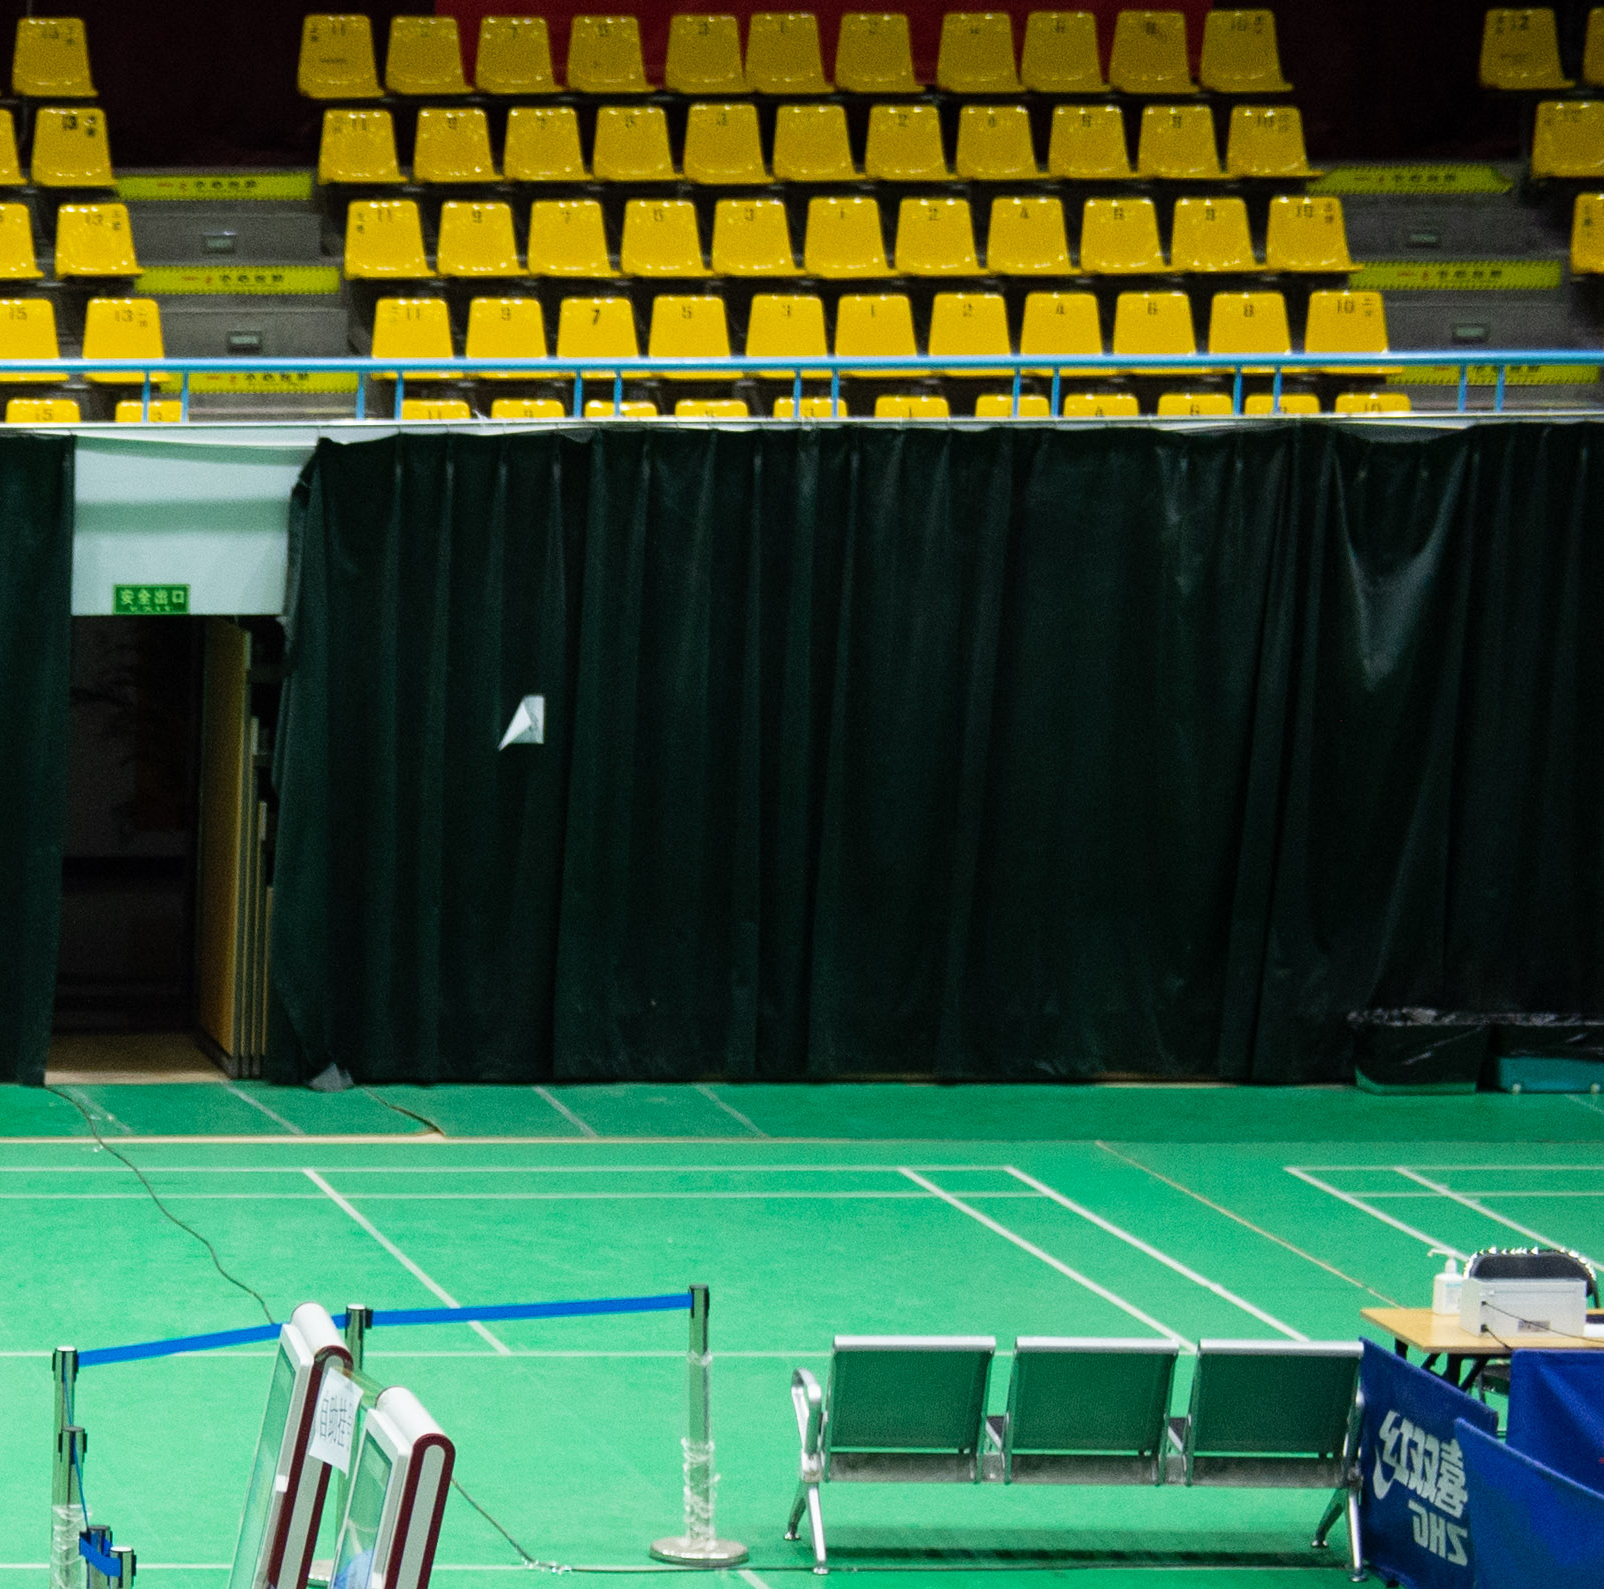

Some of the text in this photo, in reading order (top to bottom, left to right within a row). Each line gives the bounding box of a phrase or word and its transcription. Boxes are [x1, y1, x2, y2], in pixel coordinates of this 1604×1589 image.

[120, 588, 184, 605] 安全出口
[1379, 1409, 1469, 1518] 红双喜
[1407, 1499, 1469, 1567] DHS
